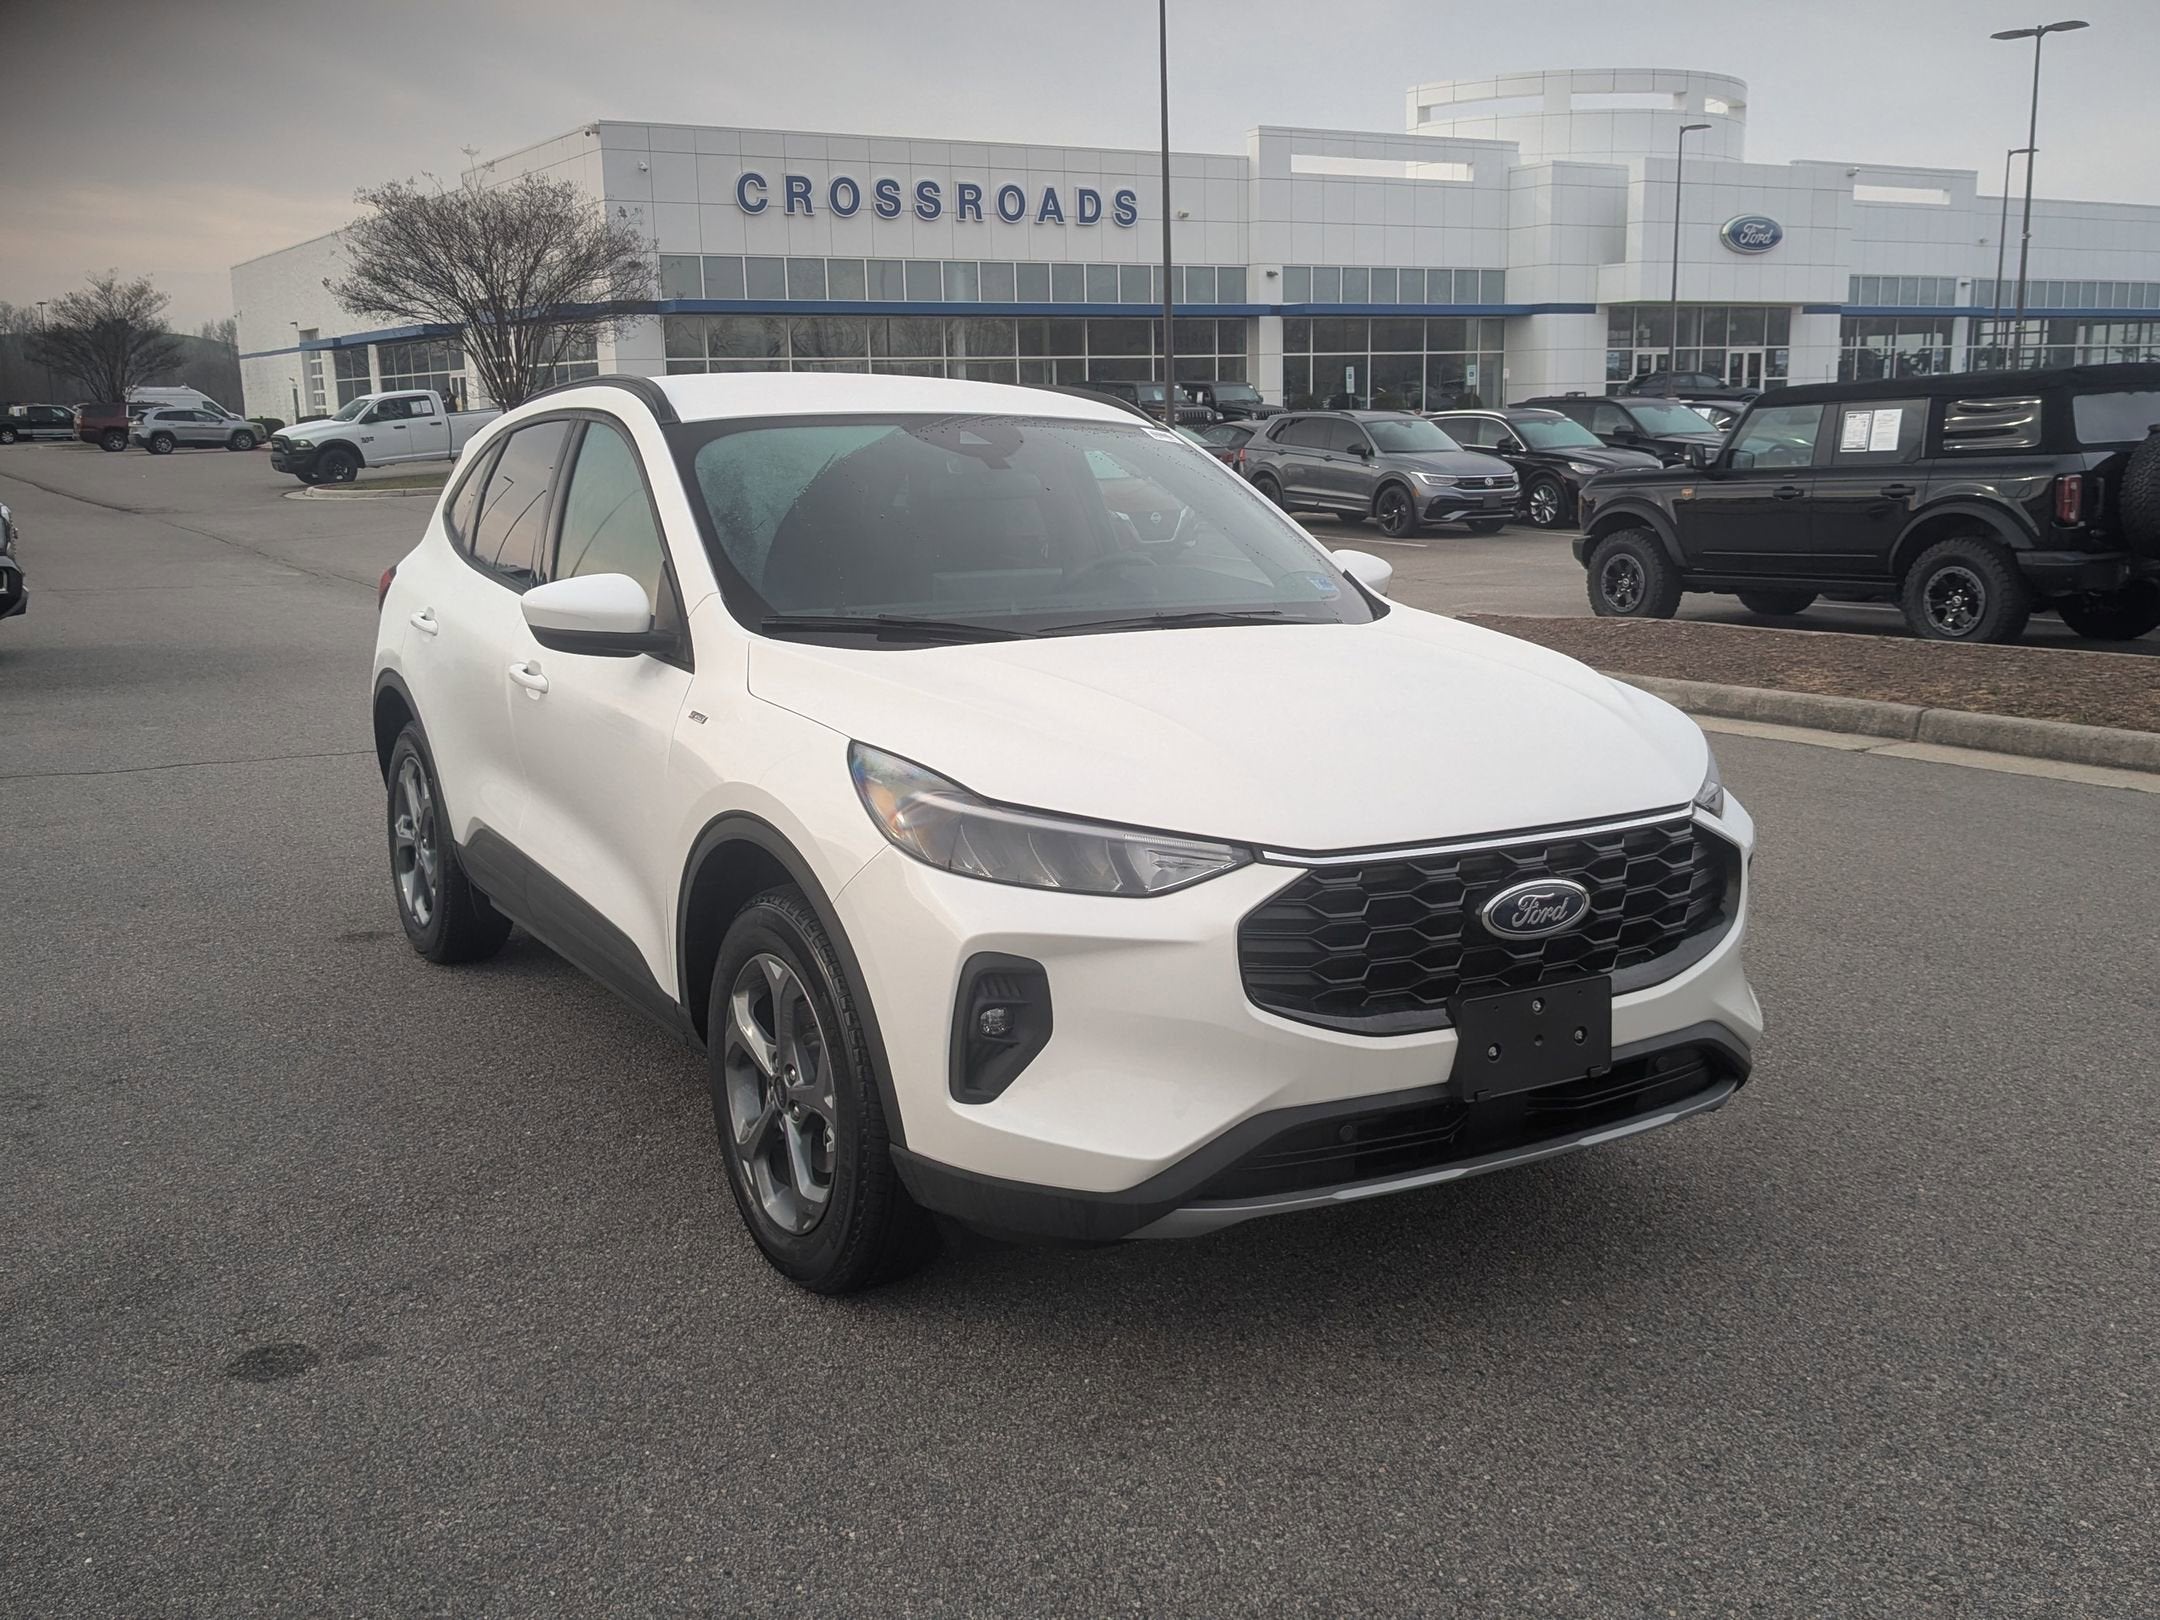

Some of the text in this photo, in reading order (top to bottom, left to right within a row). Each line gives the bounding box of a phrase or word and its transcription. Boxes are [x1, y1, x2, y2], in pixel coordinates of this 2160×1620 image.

[736, 171, 1138, 228] CROSSROADS
[1739, 222, 1774, 245] Ford
[1511, 892, 1569, 928] Ford
